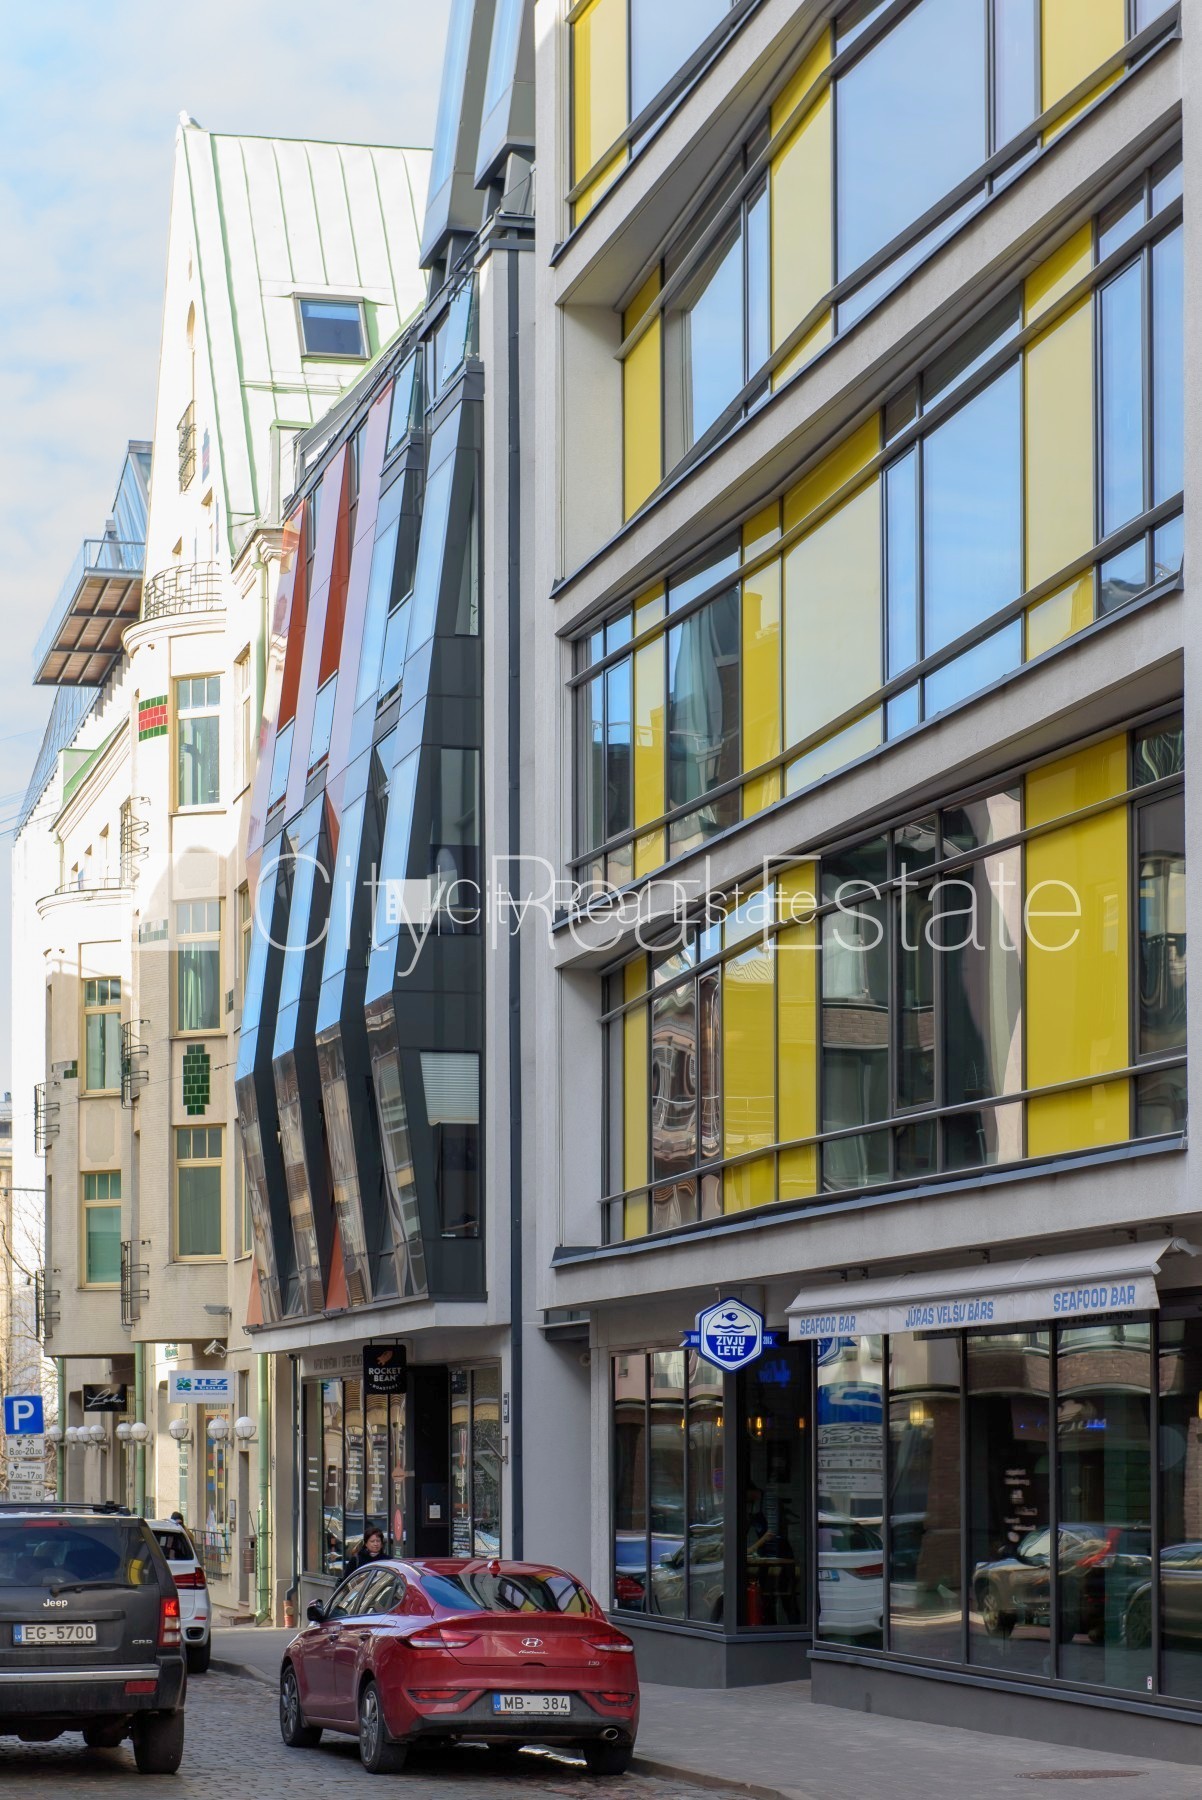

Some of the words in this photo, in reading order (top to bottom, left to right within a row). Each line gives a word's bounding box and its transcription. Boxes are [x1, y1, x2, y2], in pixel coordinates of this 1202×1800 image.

[1053, 1285, 1107, 1313] SEAFOOD
[1110, 1285, 1136, 1306] BAR
[905, 1306, 935, 1328] JŪRAS
[967, 1300, 995, 1320] BĀRS
[799, 1316, 837, 1335] SEAFOOD
[838, 1315, 857, 1332] BAR
[716, 1336, 746, 1345] ZIVJU
[717, 1346, 745, 1356] LETE
[368, 1367, 402, 1375] ROCKET
[13, 1400, 34, 1430] P
[43, 1598, 68, 1608] Jeep
[25, 1626, 94, 1640] EG-5700
